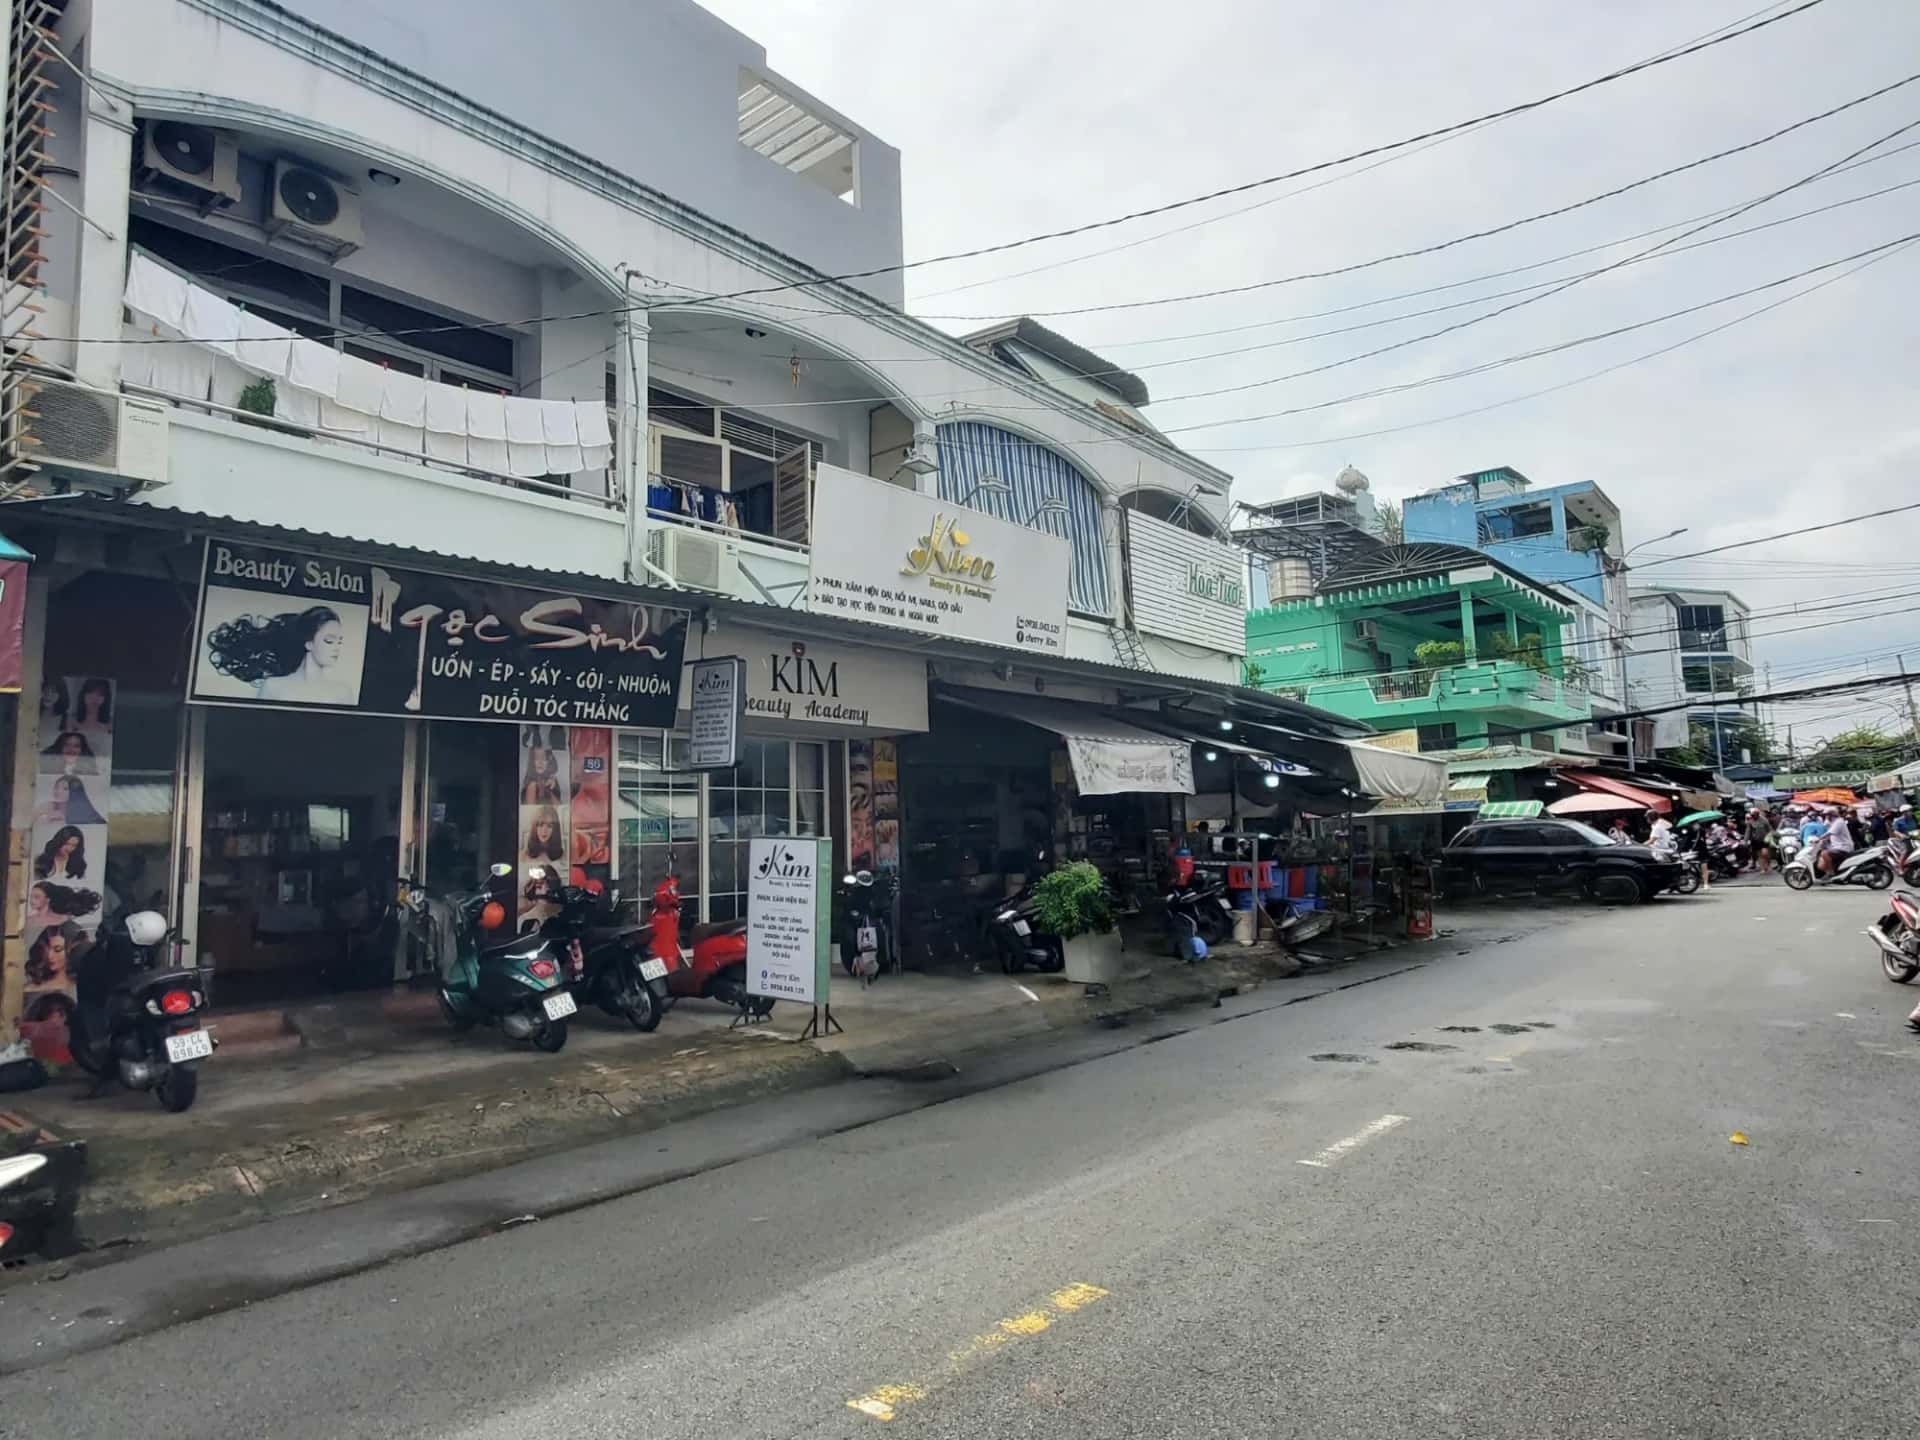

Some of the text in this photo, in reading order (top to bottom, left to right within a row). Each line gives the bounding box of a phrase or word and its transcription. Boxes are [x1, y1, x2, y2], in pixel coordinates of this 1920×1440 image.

[214, 547, 365, 594] Beauty Salon
[1186, 563, 1213, 596] Hoa
[520, 598, 668, 660] Sinh
[432, 650, 472, 680] UỐN
[491, 657, 514, 683] ÉP
[530, 656, 562, 686] SẤY
[576, 668, 604, 696] GỘI
[618, 674, 672, 698] NHUỘM
[770, 648, 840, 698] KIM
[480, 687, 630, 722] DUỖI TÓC THẲNG
[804, 699, 869, 727] Academy
[754, 843, 813, 880] Kim
